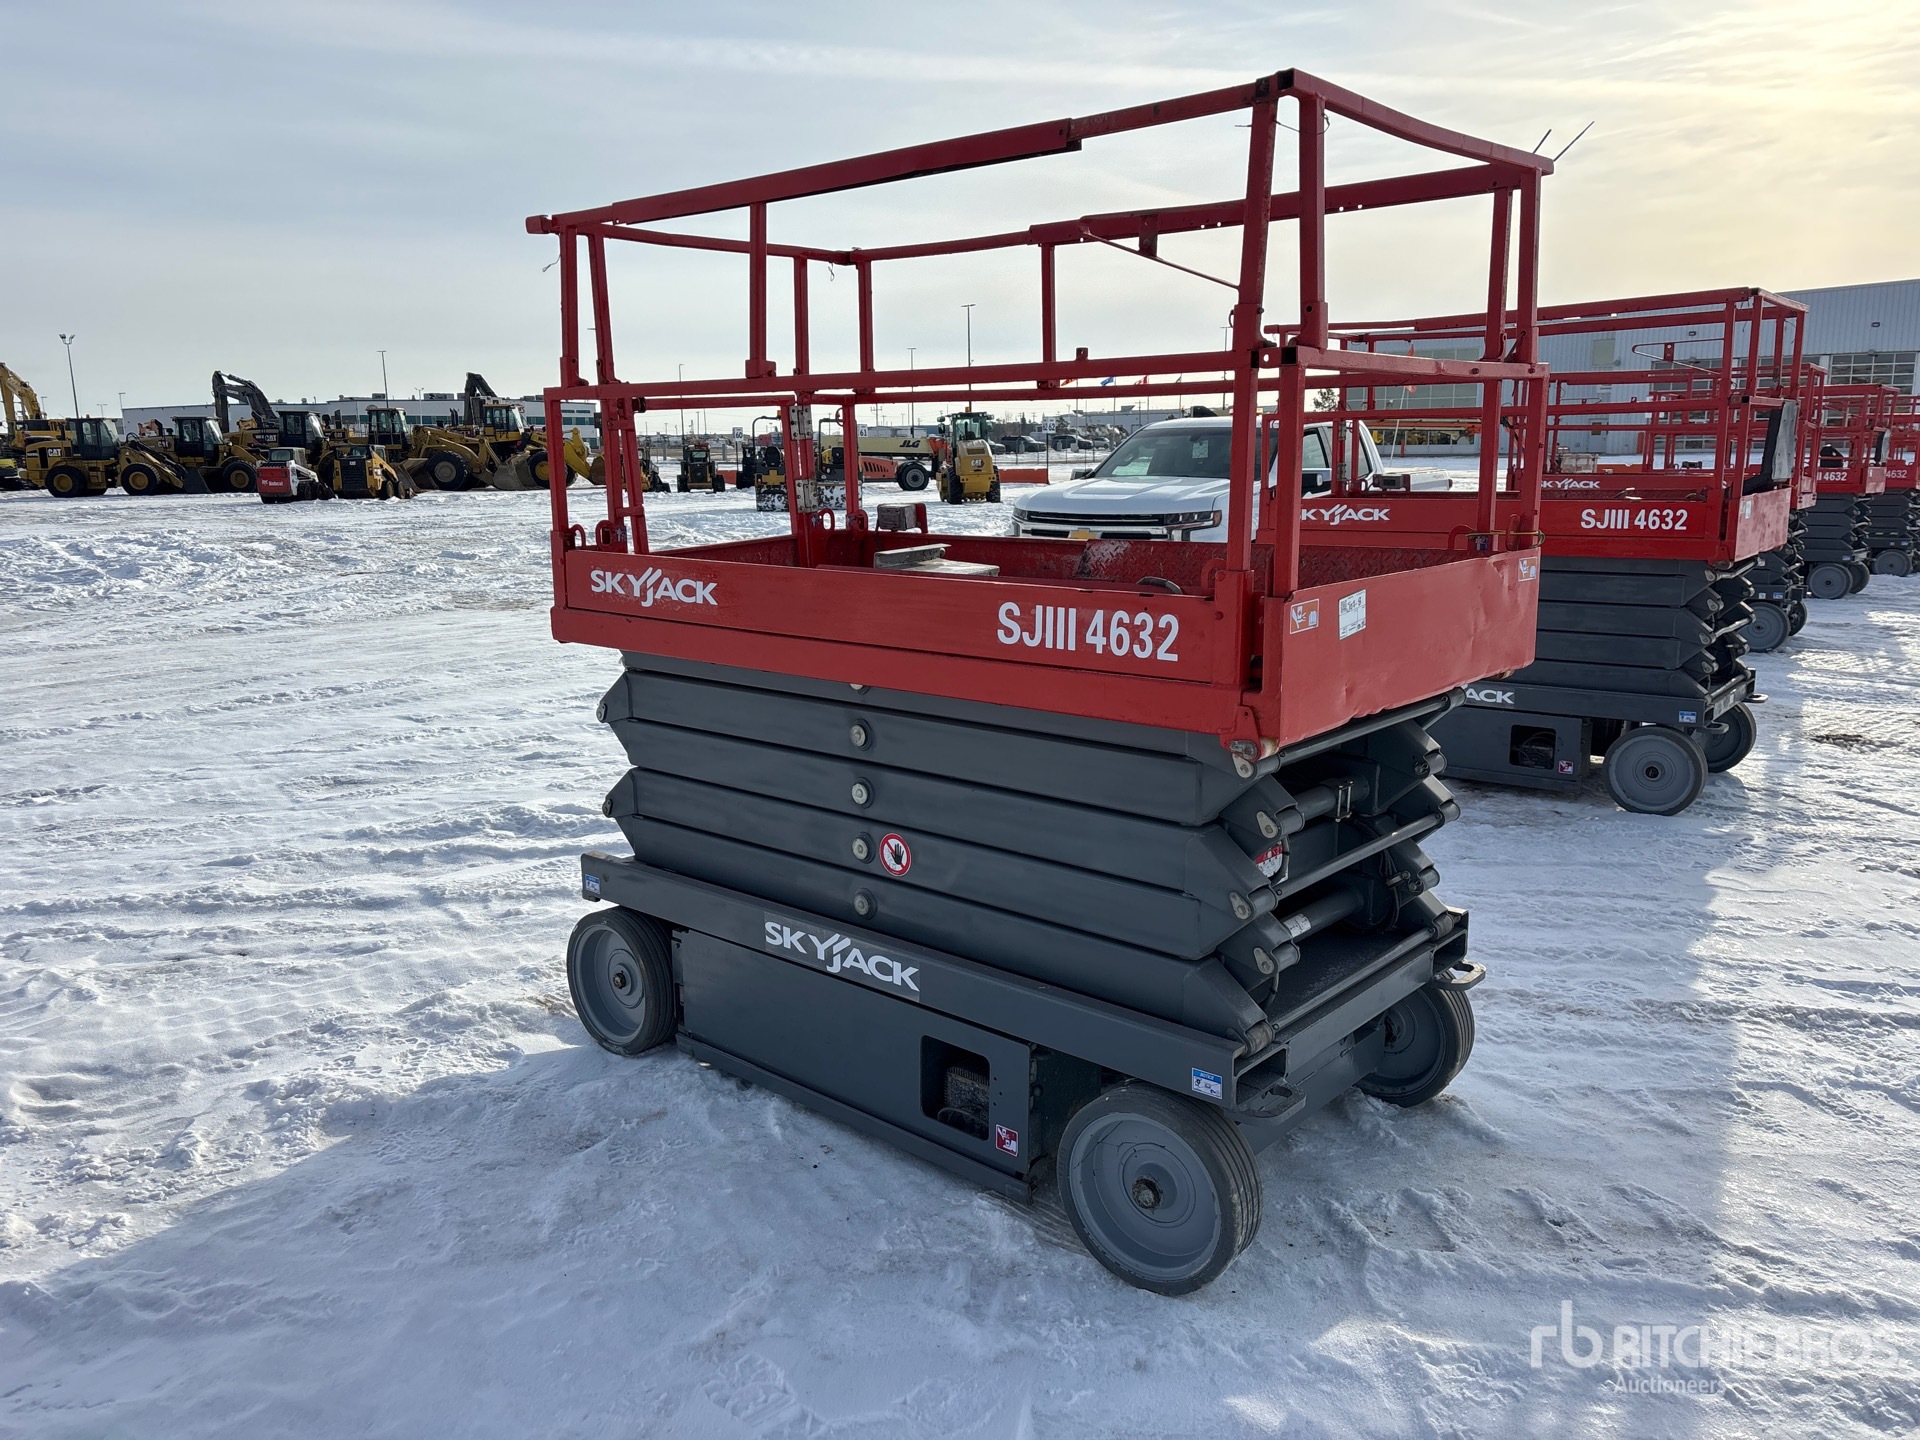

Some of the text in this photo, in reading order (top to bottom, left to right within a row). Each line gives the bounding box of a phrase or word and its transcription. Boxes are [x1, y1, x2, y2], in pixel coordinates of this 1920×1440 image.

[860, 429, 867, 437] 61
[48, 448, 61, 456] CAT
[900, 440, 920, 448] JLG
[1823, 471, 1848, 481] 4632
[1300, 504, 1390, 525] KYJACK
[1634, 509, 1688, 530] 4632
[590, 567, 718, 607] SKYJACK
[1085, 610, 1179, 662] 4632
[765, 921, 919, 992] SKYJACK
